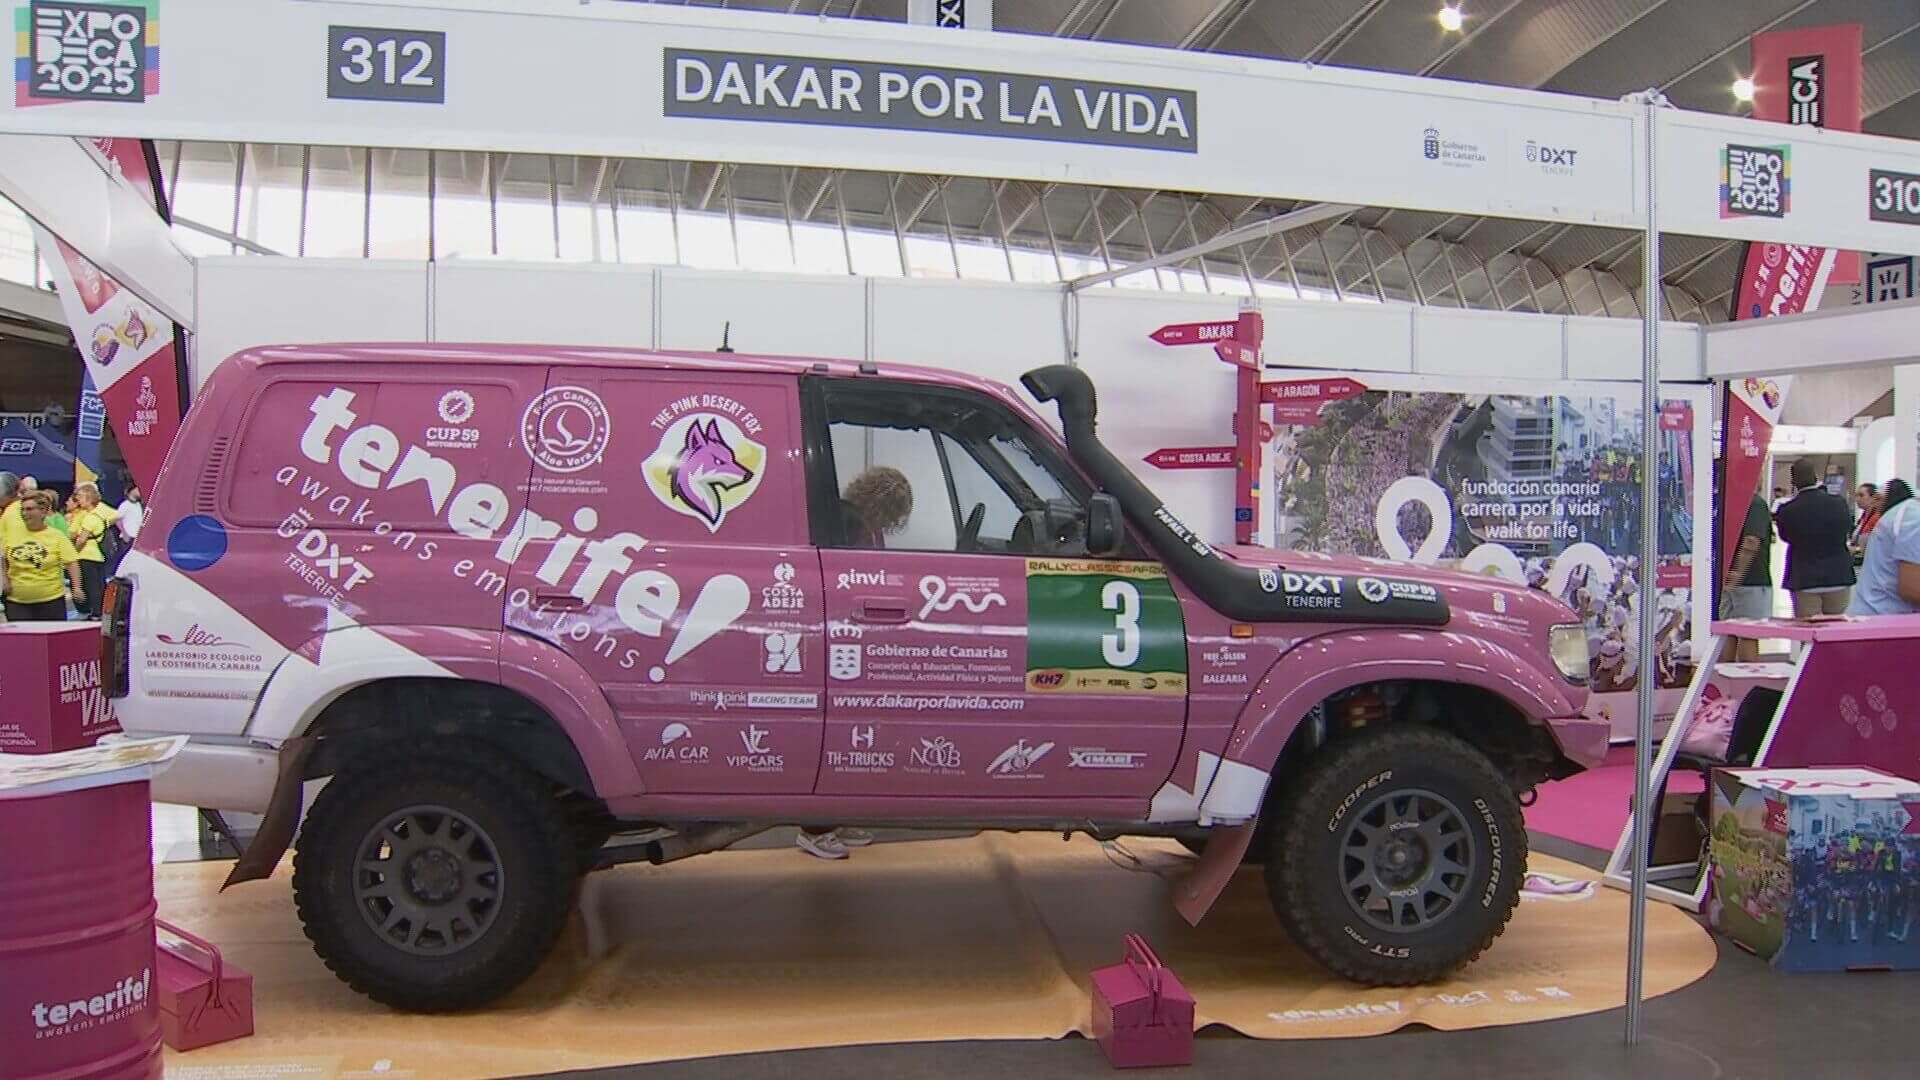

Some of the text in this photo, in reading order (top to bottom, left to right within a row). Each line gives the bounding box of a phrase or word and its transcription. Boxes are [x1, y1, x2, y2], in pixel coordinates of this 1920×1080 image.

[36, 8, 140, 42] EXPO
[36, 36, 138, 68] DECA
[340, 37, 434, 86] 312
[36, 63, 135, 95] 2025
[676, 58, 1190, 138] DAKAR POR LA VIDA
[1791, 60, 1819, 128] ECA
[1540, 147, 1577, 165] DXT
[1729, 150, 1782, 174] EXPO
[1729, 170, 1780, 194] DECA
[1730, 190, 1779, 213] 2025
[1875, 177, 1920, 215] 310
[1198, 325, 1234, 339] DAKAR
[650, 394, 763, 435] THE PINK DESERT FOX
[426, 427, 480, 442] CUP 59
[1462, 478, 1600, 495] fundación canaria
[1461, 500, 1600, 520] carrera por la vida
[300, 387, 750, 684] tenerife!
[1485, 521, 1578, 538] walk for life
[297, 528, 374, 591] DXT
[284, 552, 345, 608] TENERIFE
[849, 568, 886, 586] invi
[1282, 574, 1343, 595] DXT
[1389, 582, 1418, 593] CUP
[762, 587, 804, 597] COSTA
[1285, 596, 1342, 608] TENERIFE
[453, 559, 640, 669] emotions
[762, 598, 805, 609] ADEJE
[1102, 580, 1141, 668] 3
[145, 651, 262, 663] LABORATORIO ECOLOGICO
[867, 644, 1008, 659] Gobierno de Canarias
[147, 660, 158, 668] DE
[220, 661, 261, 671] CANARIA
[1034, 673, 1065, 686] KH7
[81, 687, 116, 727] VID
[751, 695, 787, 705] RACING
[788, 696, 815, 705] TEAM
[833, 694, 1024, 711] www.dakarporlavida.com
[643, 746, 709, 761] AVIA CAR
[726, 755, 785, 768] VIPCARS
[826, 751, 895, 767] TH-TRUCKS
[1328, 770, 1392, 833] COOPER
[1474, 798, 1502, 909] DISCOVERER
[32, 967, 150, 1028] tenerife!
